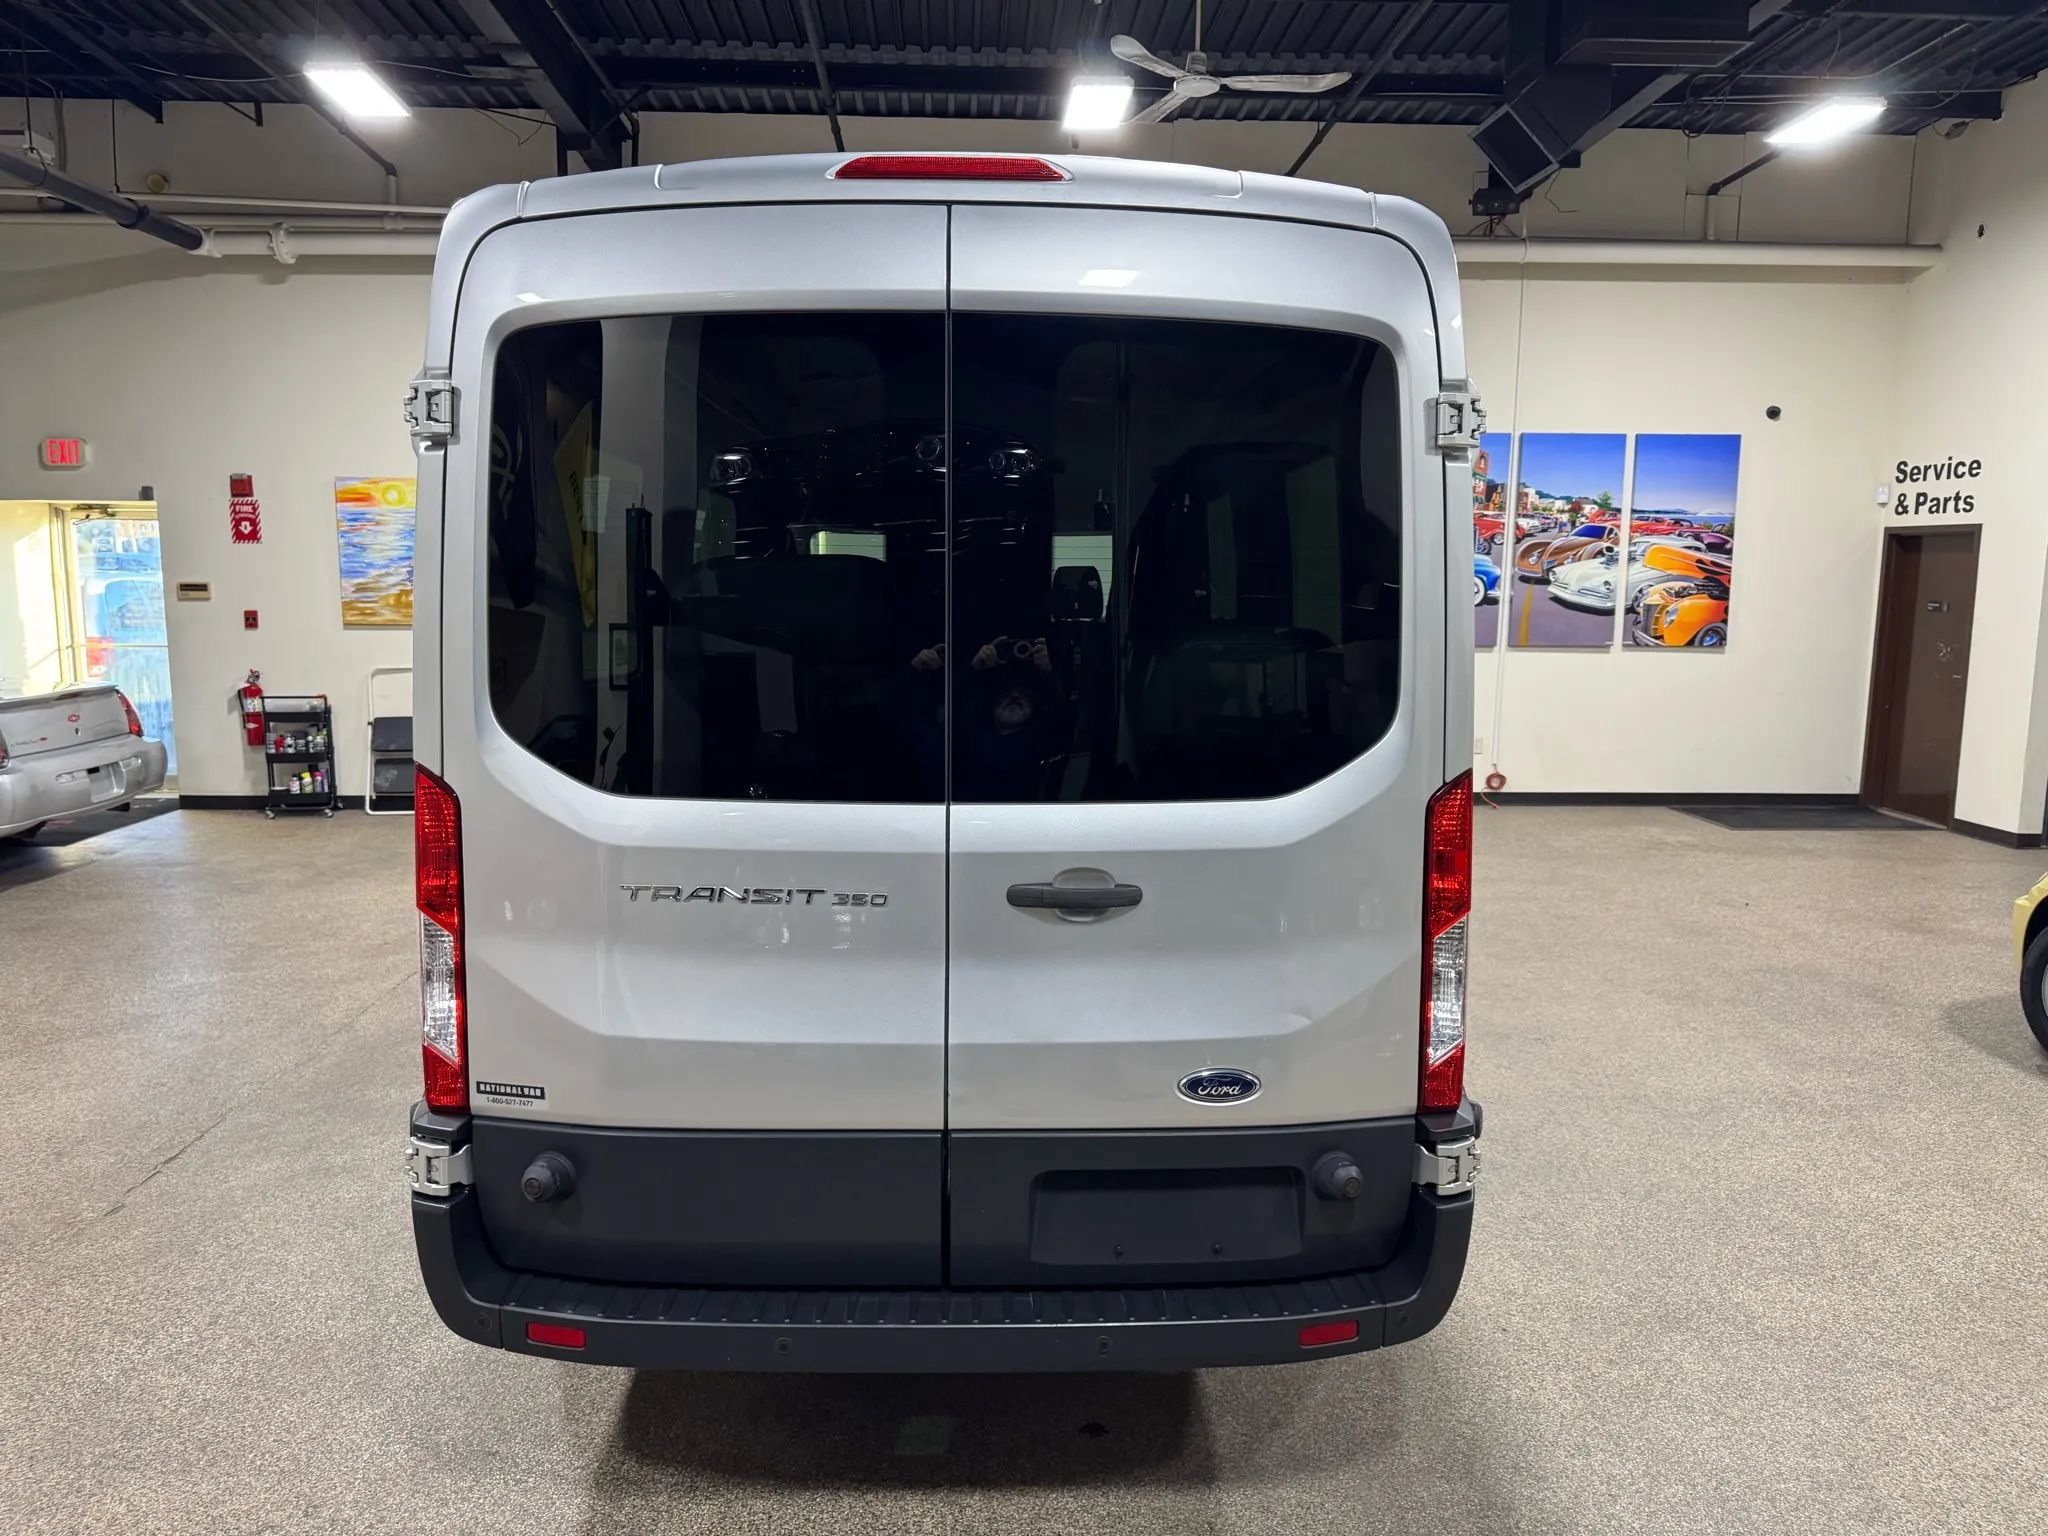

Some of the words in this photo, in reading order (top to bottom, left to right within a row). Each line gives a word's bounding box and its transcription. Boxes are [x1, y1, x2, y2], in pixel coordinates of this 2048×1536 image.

[47, 439, 80, 464] EXIT
[1895, 456, 1982, 484] Service
[235, 504, 254, 512] FIRE
[1894, 493, 1909, 515] &
[1914, 490, 1975, 515] Parts
[619, 883, 827, 905] TRANSIT
[832, 891, 889, 907] 350
[479, 1083, 523, 1095] NATIONAL
[523, 1087, 542, 1097] VAN
[1197, 1076, 1242, 1095] Ford
[486, 1096, 534, 1107] 1-800-527-7477
